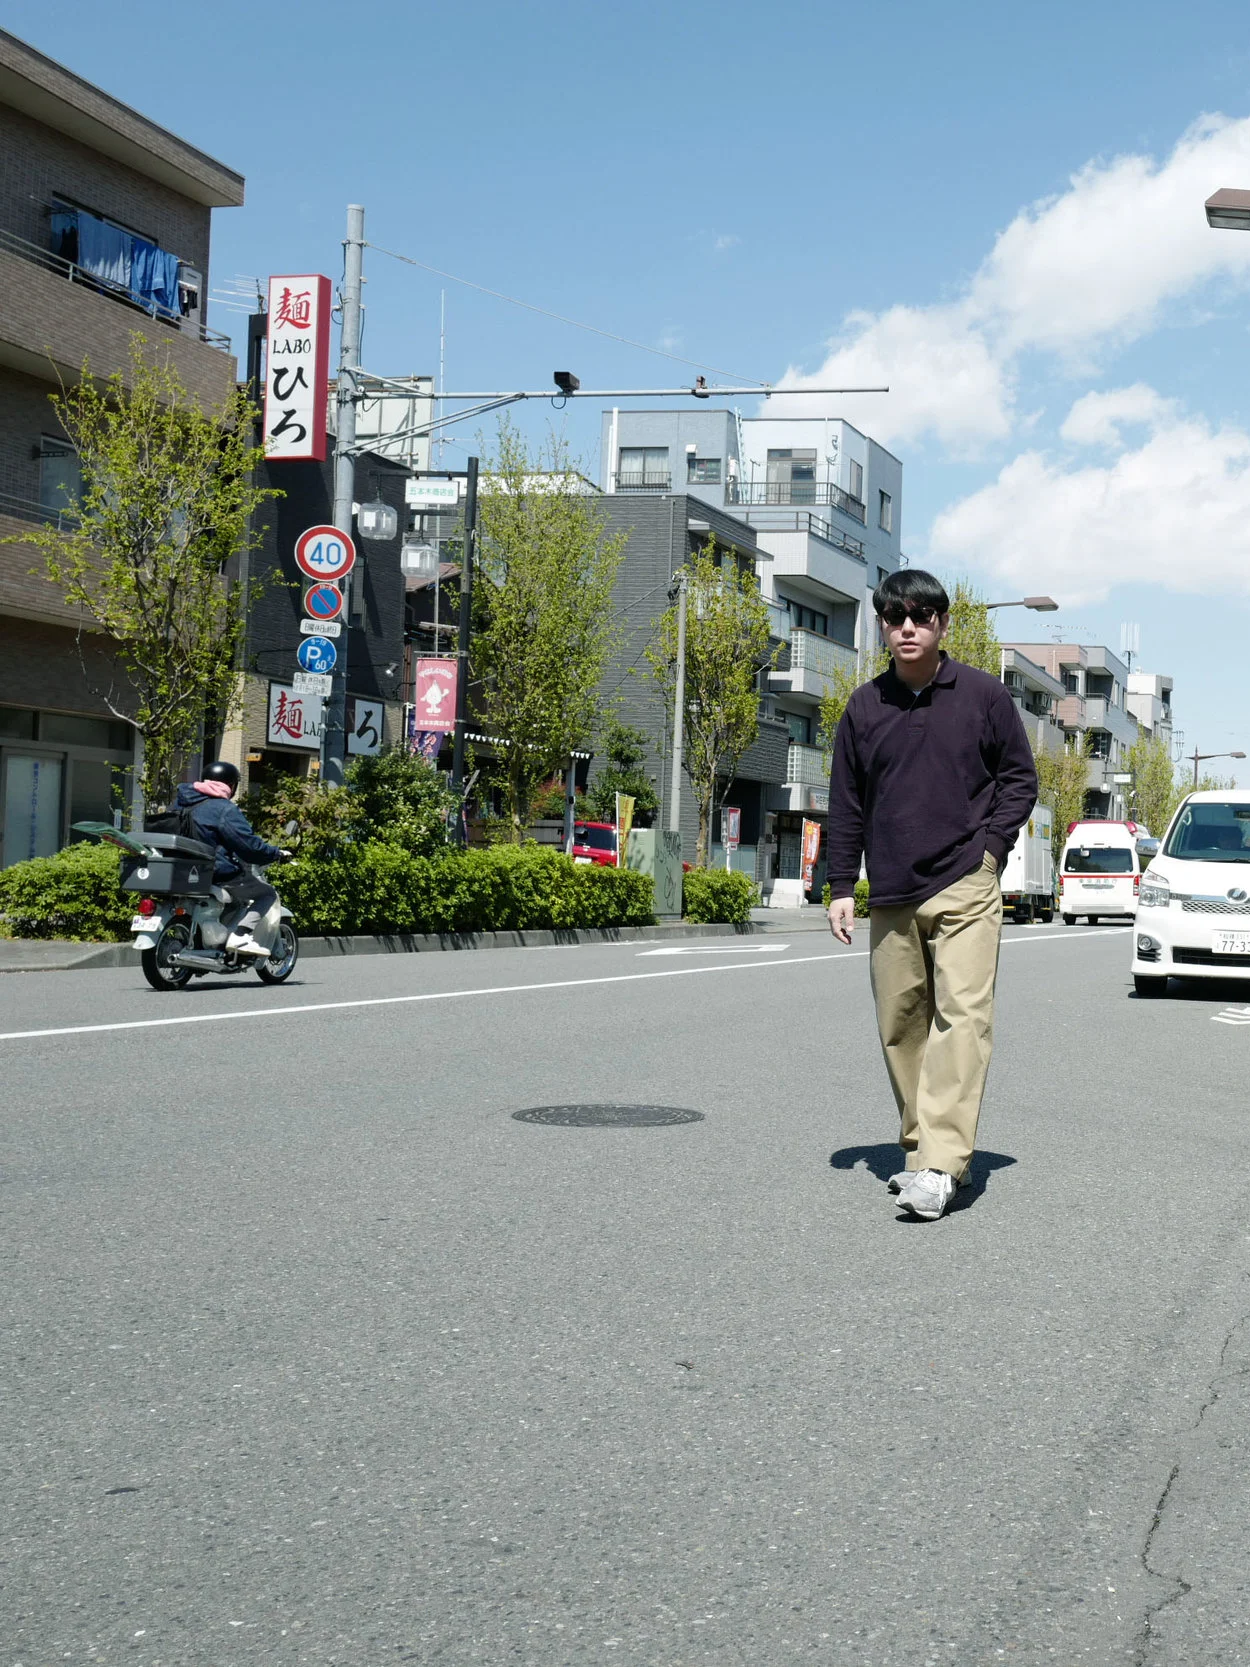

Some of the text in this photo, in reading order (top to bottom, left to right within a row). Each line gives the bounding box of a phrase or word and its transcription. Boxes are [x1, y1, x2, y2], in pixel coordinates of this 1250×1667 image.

[274, 287, 311, 330] 麺
[273, 338, 311, 354] LABO
[271, 366, 308, 443] ひろ
[310, 542, 341, 565] 40
[306, 646, 321, 668] P
[272, 691, 303, 739] 麺
[357, 710, 378, 748] ろ
